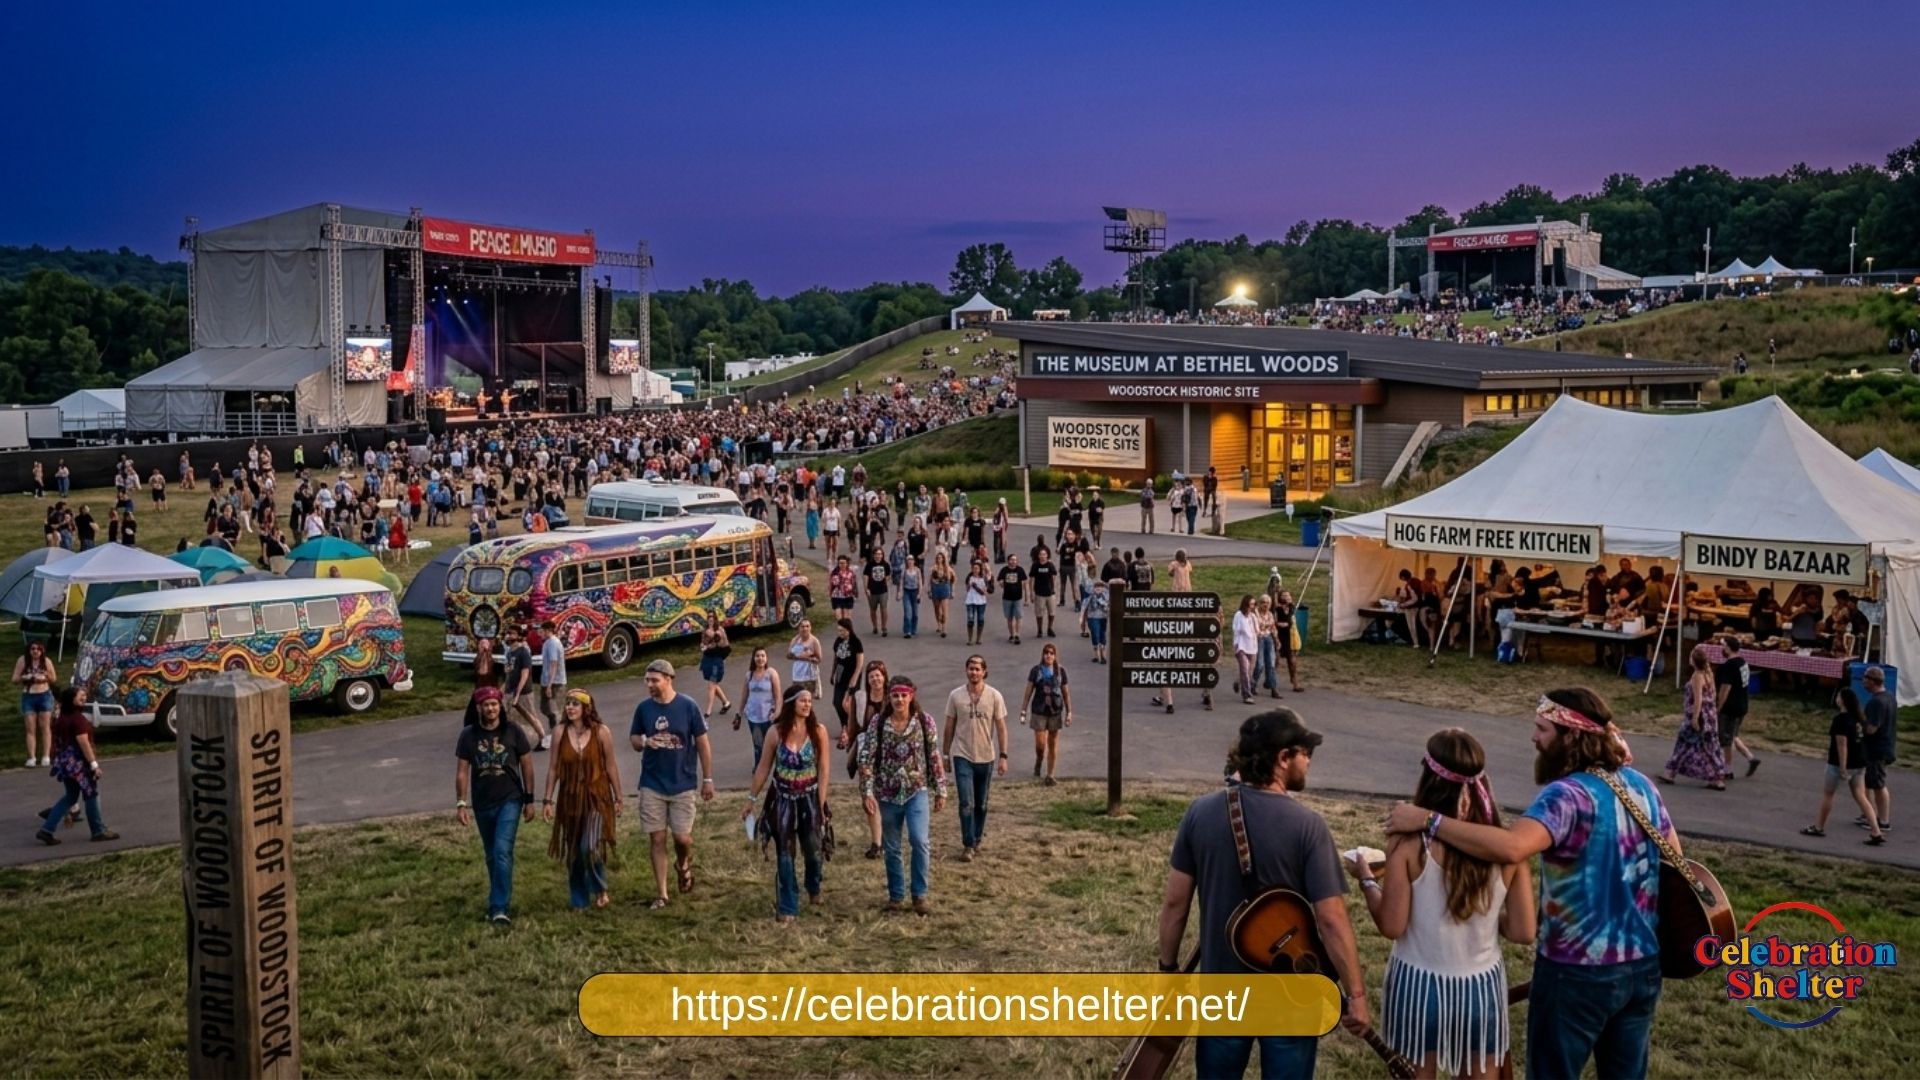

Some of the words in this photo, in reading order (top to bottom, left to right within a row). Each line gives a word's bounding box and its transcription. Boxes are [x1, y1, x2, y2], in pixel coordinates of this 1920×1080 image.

[470, 228, 511, 255] PEACE
[1037, 356, 1069, 372] THE
[1074, 356, 1149, 372] MUSEUM
[1155, 356, 1177, 372] AT
[1183, 355, 1255, 372] BETHEL
[1261, 355, 1339, 373] WOODS
[1108, 385, 1177, 397] WOODSTOCK
[1180, 386, 1232, 398] HISTORIC
[1234, 386, 1260, 398] SITE
[1052, 421, 1140, 437] WOODSTOCK
[1394, 522, 1426, 543] HOG
[1430, 525, 1471, 546] FARM
[1476, 528, 1515, 549] FREE
[1519, 531, 1591, 554] KITCHEN
[1697, 543, 1758, 569] BINDY
[1764, 548, 1850, 576] BAZAAR
[1194, 597, 1214, 608] SITE
[1143, 620, 1194, 635] MUSEUM
[1141, 646, 1195, 660] CAMPING
[1131, 670, 1167, 684] PEACE
[1170, 671, 1200, 685] PATH
[250, 729, 283, 828] SPIRIT
[190, 733, 232, 910] WOODSTOCK
[254, 837, 285, 873] OF
[198, 919, 234, 957] OF
[256, 881, 292, 1071] WOODSTOCK
[201, 966, 235, 1062] SPIRIT
